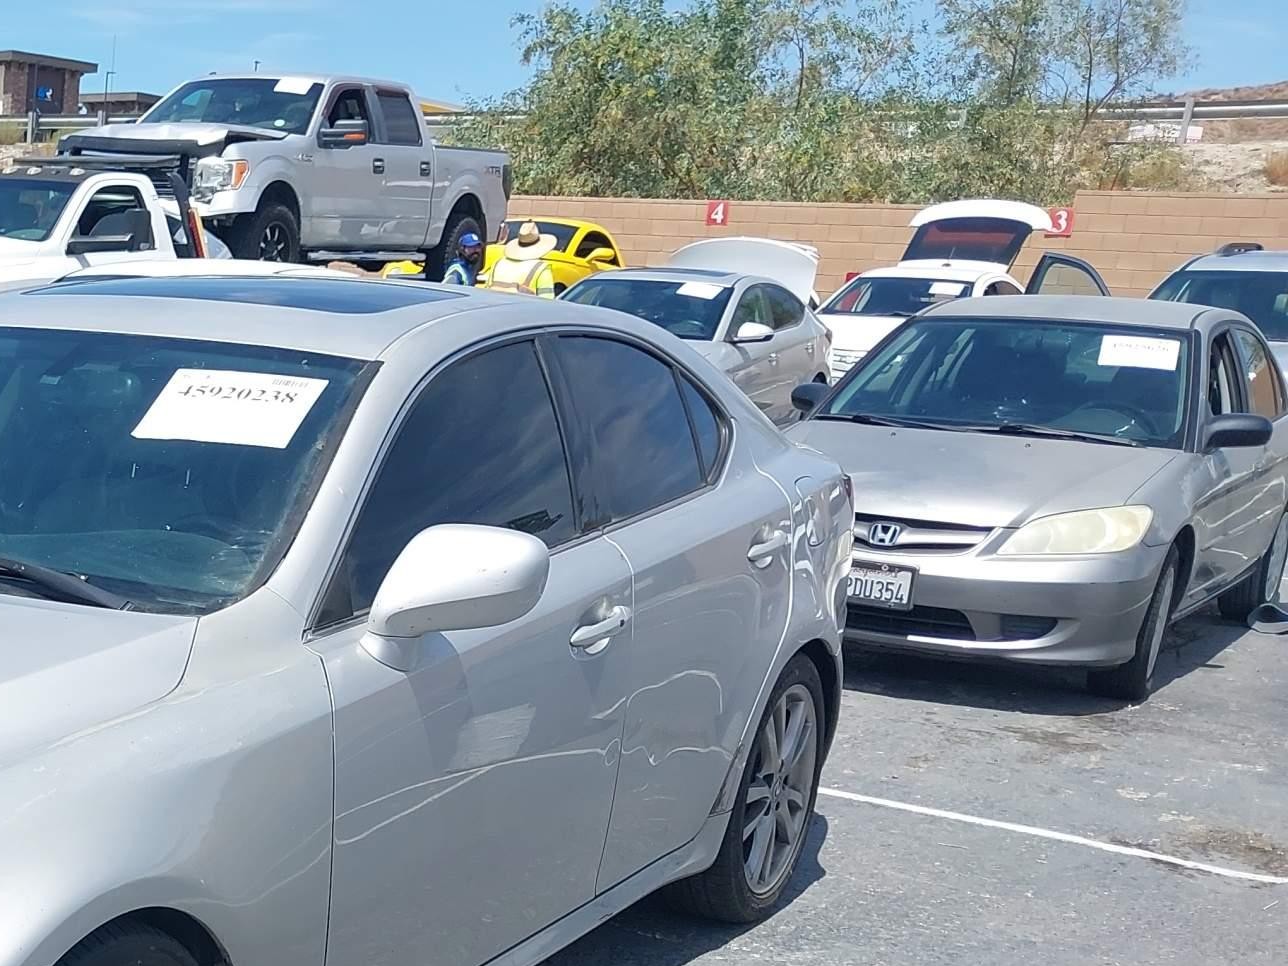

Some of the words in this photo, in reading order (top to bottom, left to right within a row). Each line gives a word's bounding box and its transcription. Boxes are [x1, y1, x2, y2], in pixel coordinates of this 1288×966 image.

[710, 202, 724, 224] 4
[1052, 210, 1068, 233] 3
[178, 385, 298, 403] 45920238
